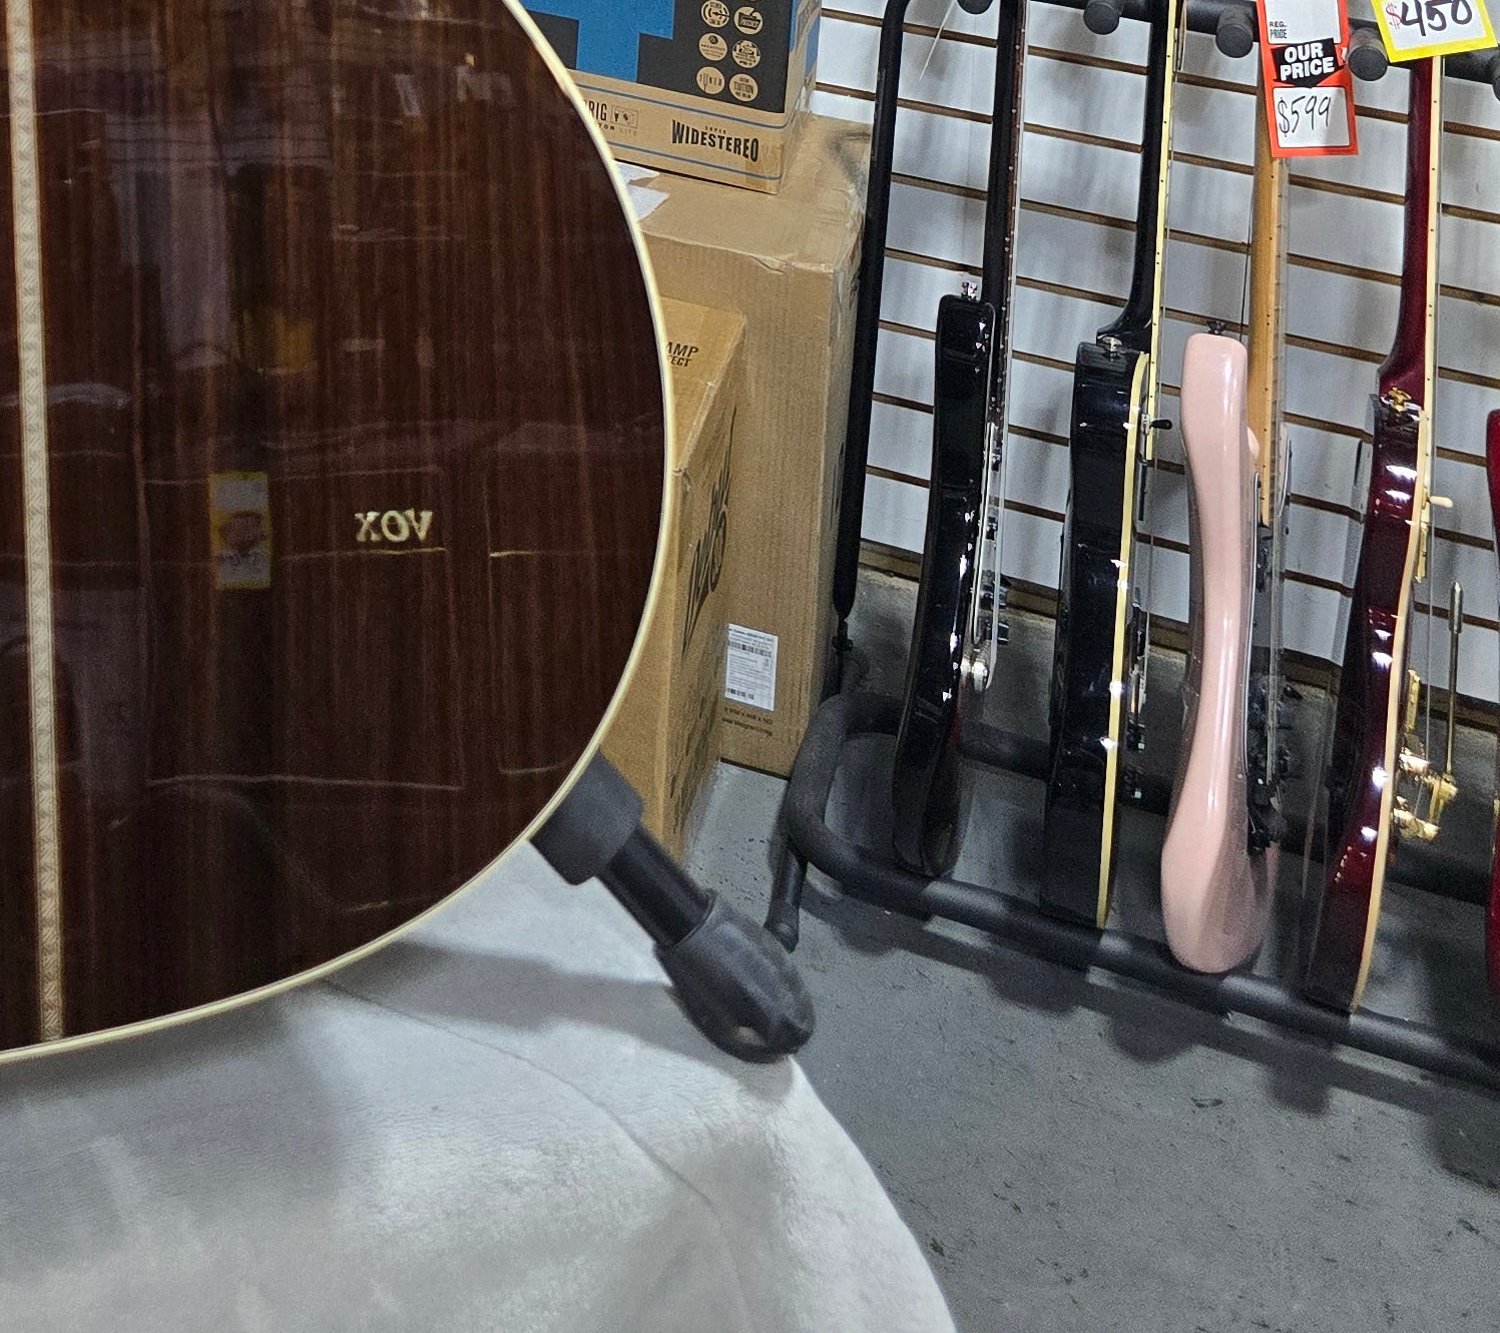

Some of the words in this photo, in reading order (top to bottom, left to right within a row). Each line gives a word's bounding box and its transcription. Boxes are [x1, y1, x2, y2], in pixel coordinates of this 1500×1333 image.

[1280, 56, 1335, 82] PRICE
[1284, 42, 1324, 64] OUR
[1277, 95, 1332, 138] $599
[671, 119, 760, 163] WIDESTEREO
